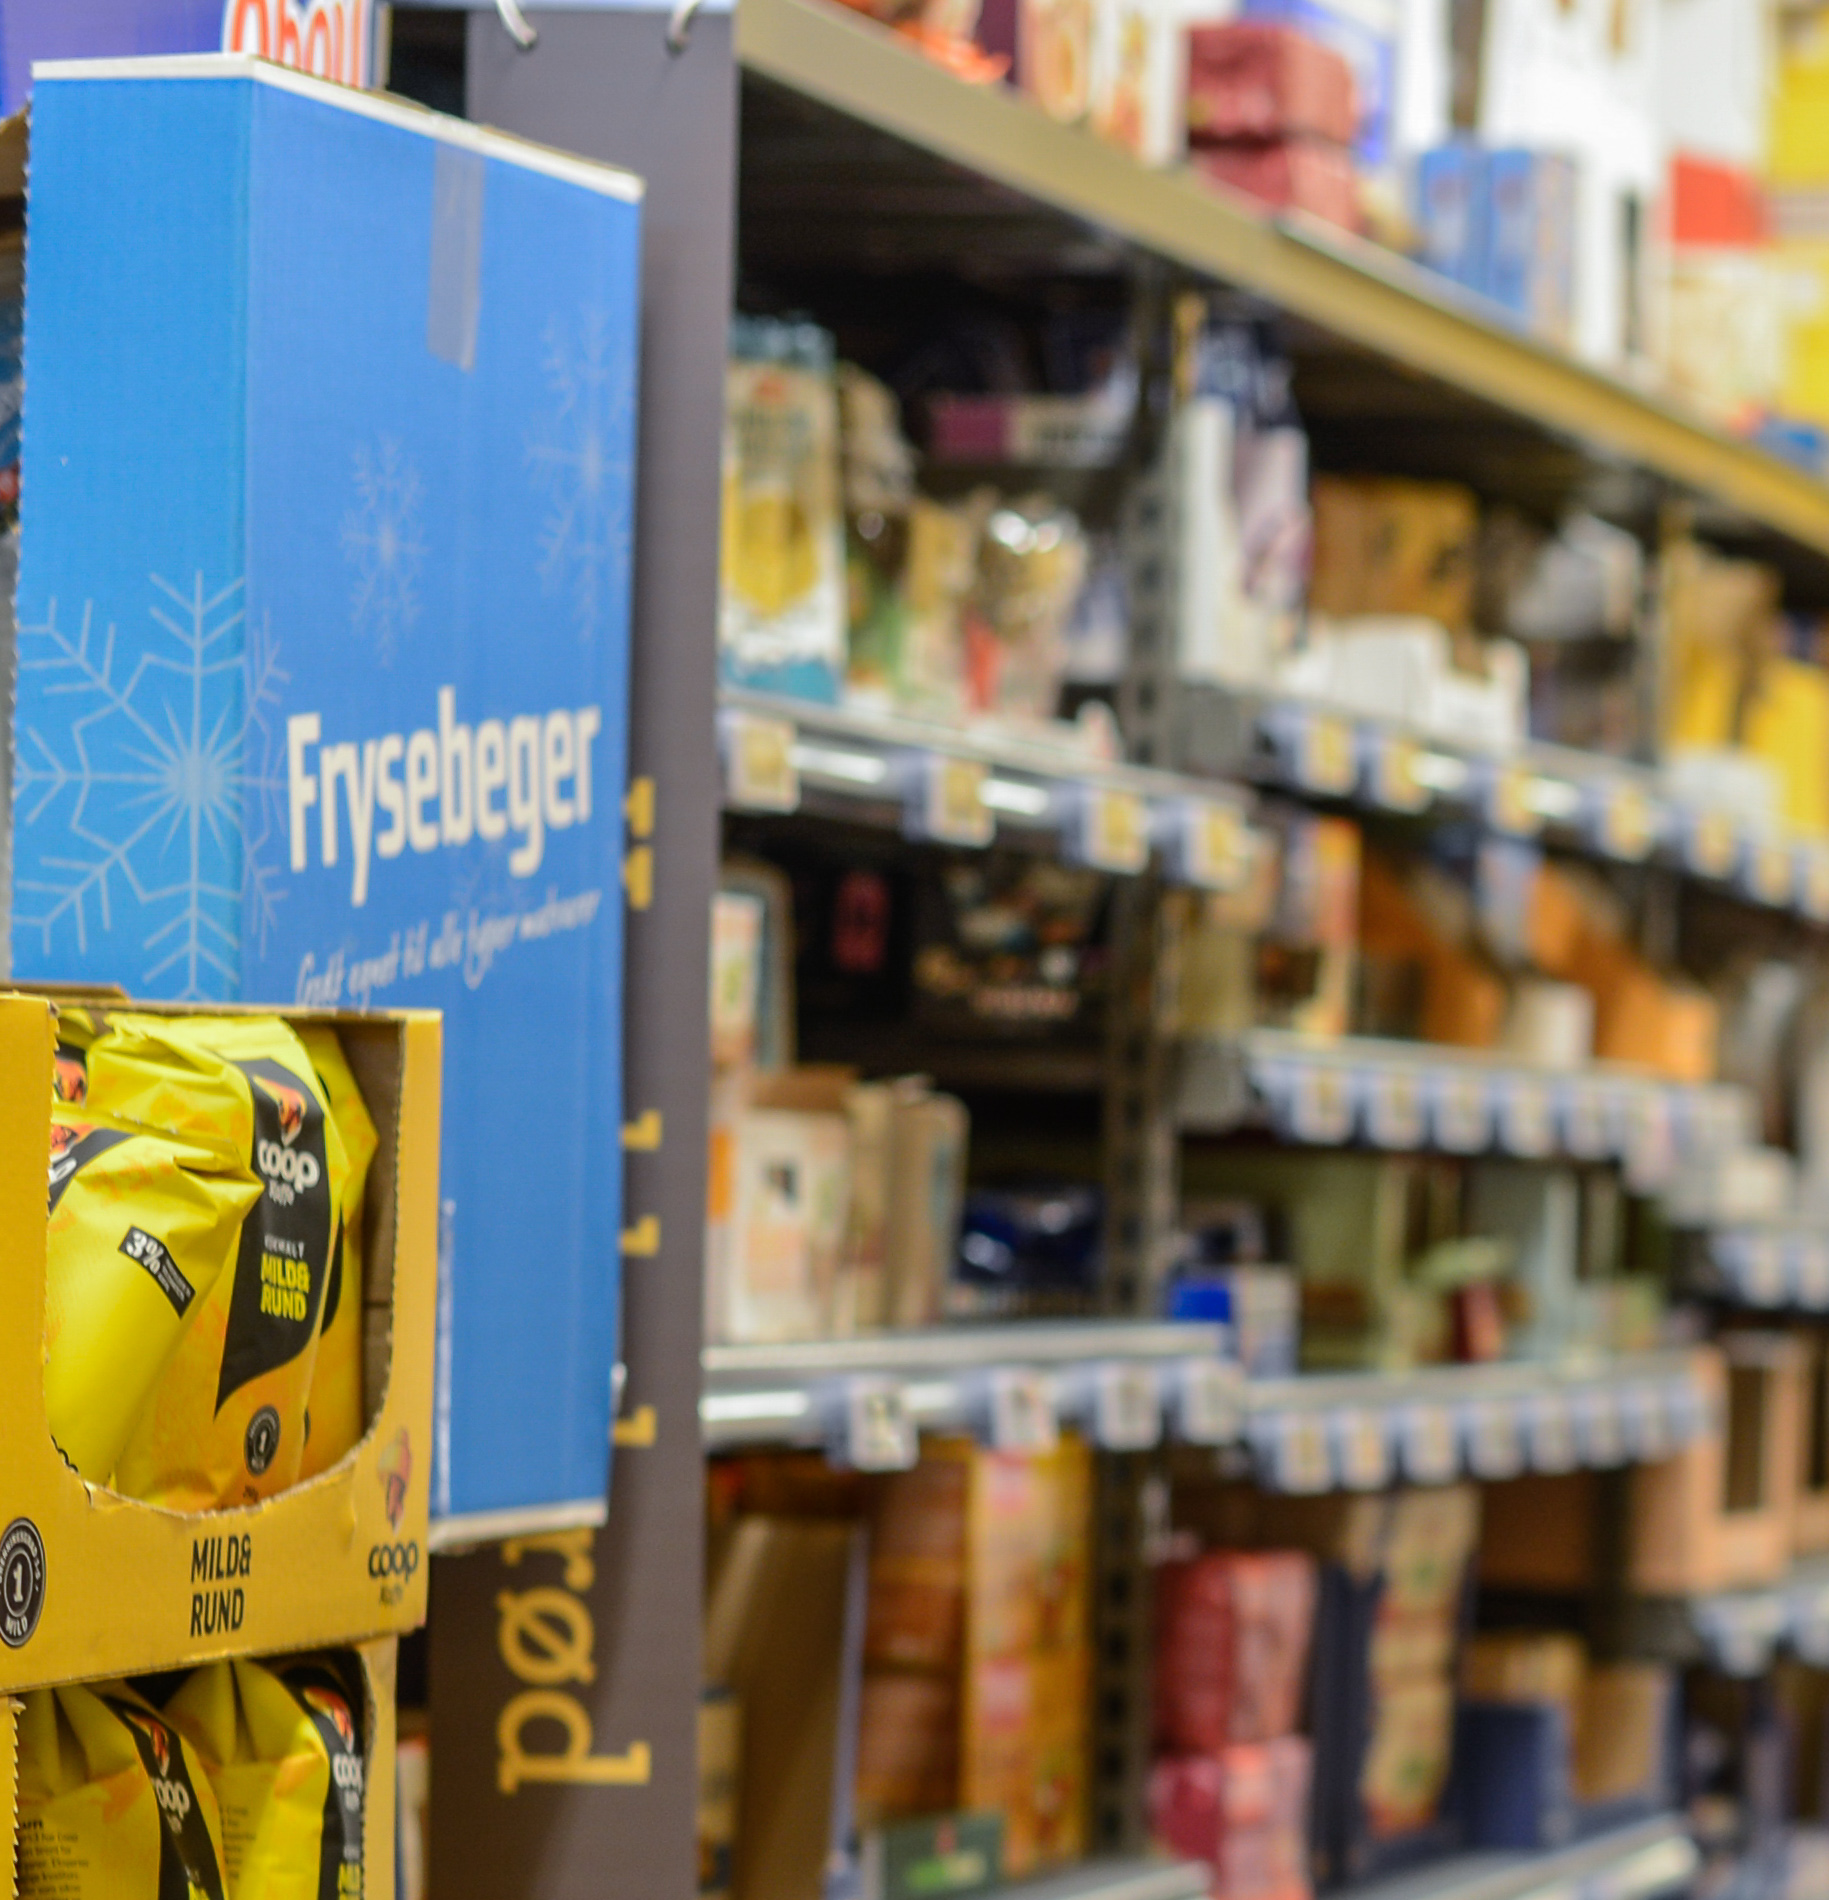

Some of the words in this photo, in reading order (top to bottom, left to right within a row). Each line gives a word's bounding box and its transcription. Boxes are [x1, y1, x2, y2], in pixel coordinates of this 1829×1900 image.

[288, 684, 601, 908] Frysebeger
[258, 1138, 320, 1194] coop
[260, 1251, 311, 1295] MILD&
[260, 1288, 307, 1323] RUND
[191, 1532, 252, 1581] MILD&
[368, 1539, 420, 1584] coop
[13, 1562, 24, 1602] 1
[190, 1586, 245, 1638] RUND
